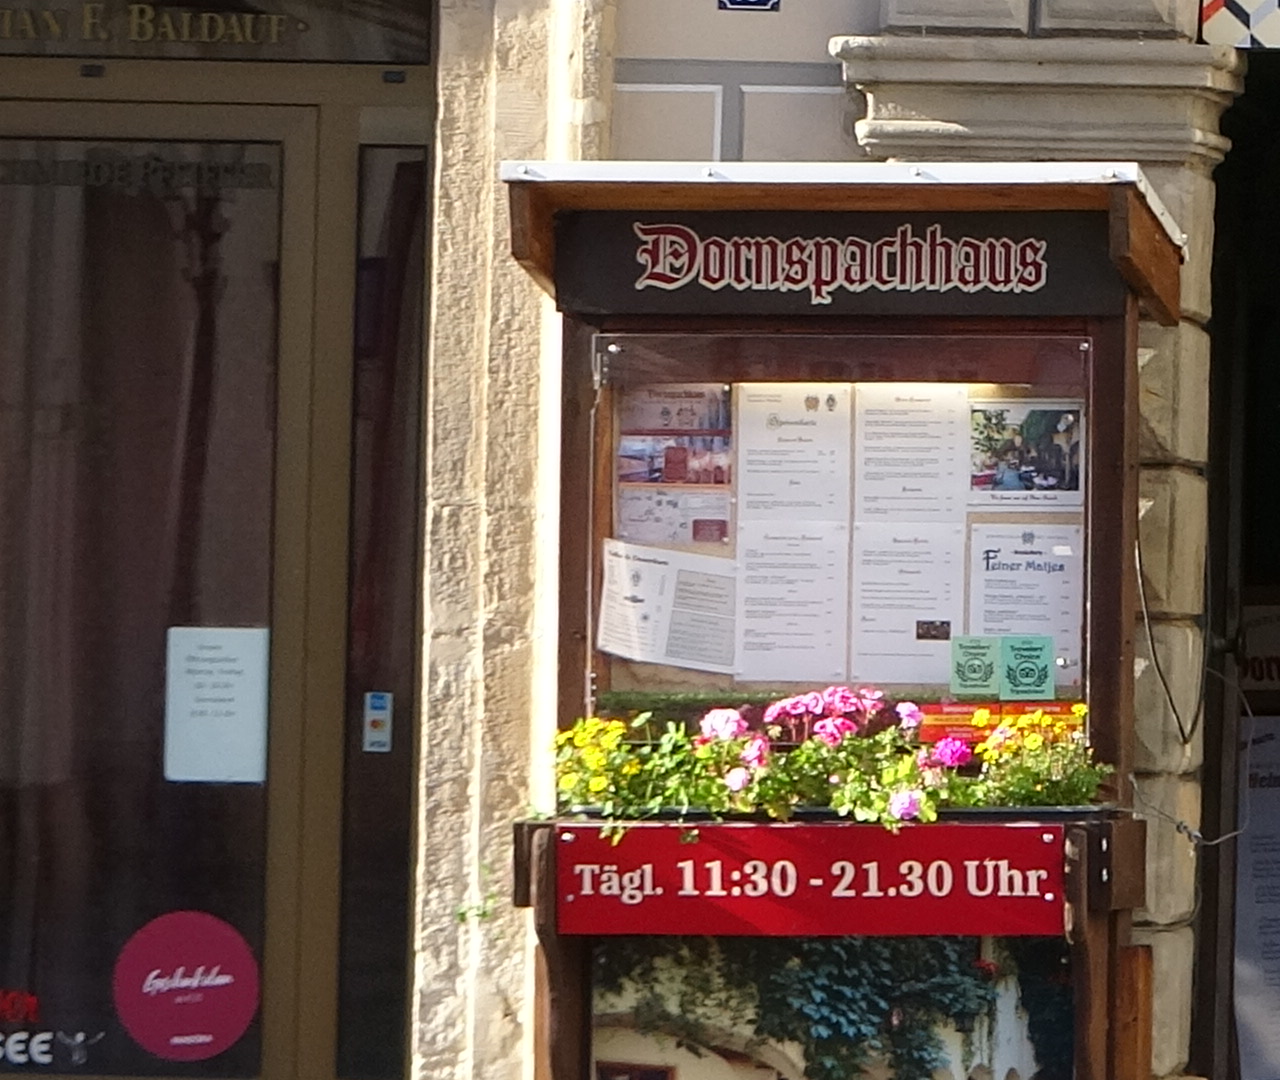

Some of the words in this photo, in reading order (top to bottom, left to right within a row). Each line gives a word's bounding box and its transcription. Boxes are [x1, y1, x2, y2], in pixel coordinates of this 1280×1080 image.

[632, 222, 1047, 306] Dornspachhaus
[573, 863, 664, 905] Tägl.
[676, 860, 798, 898] 11:30
[831, 860, 953, 898] 21.30
[0, 1030, 55, 1065] EE
